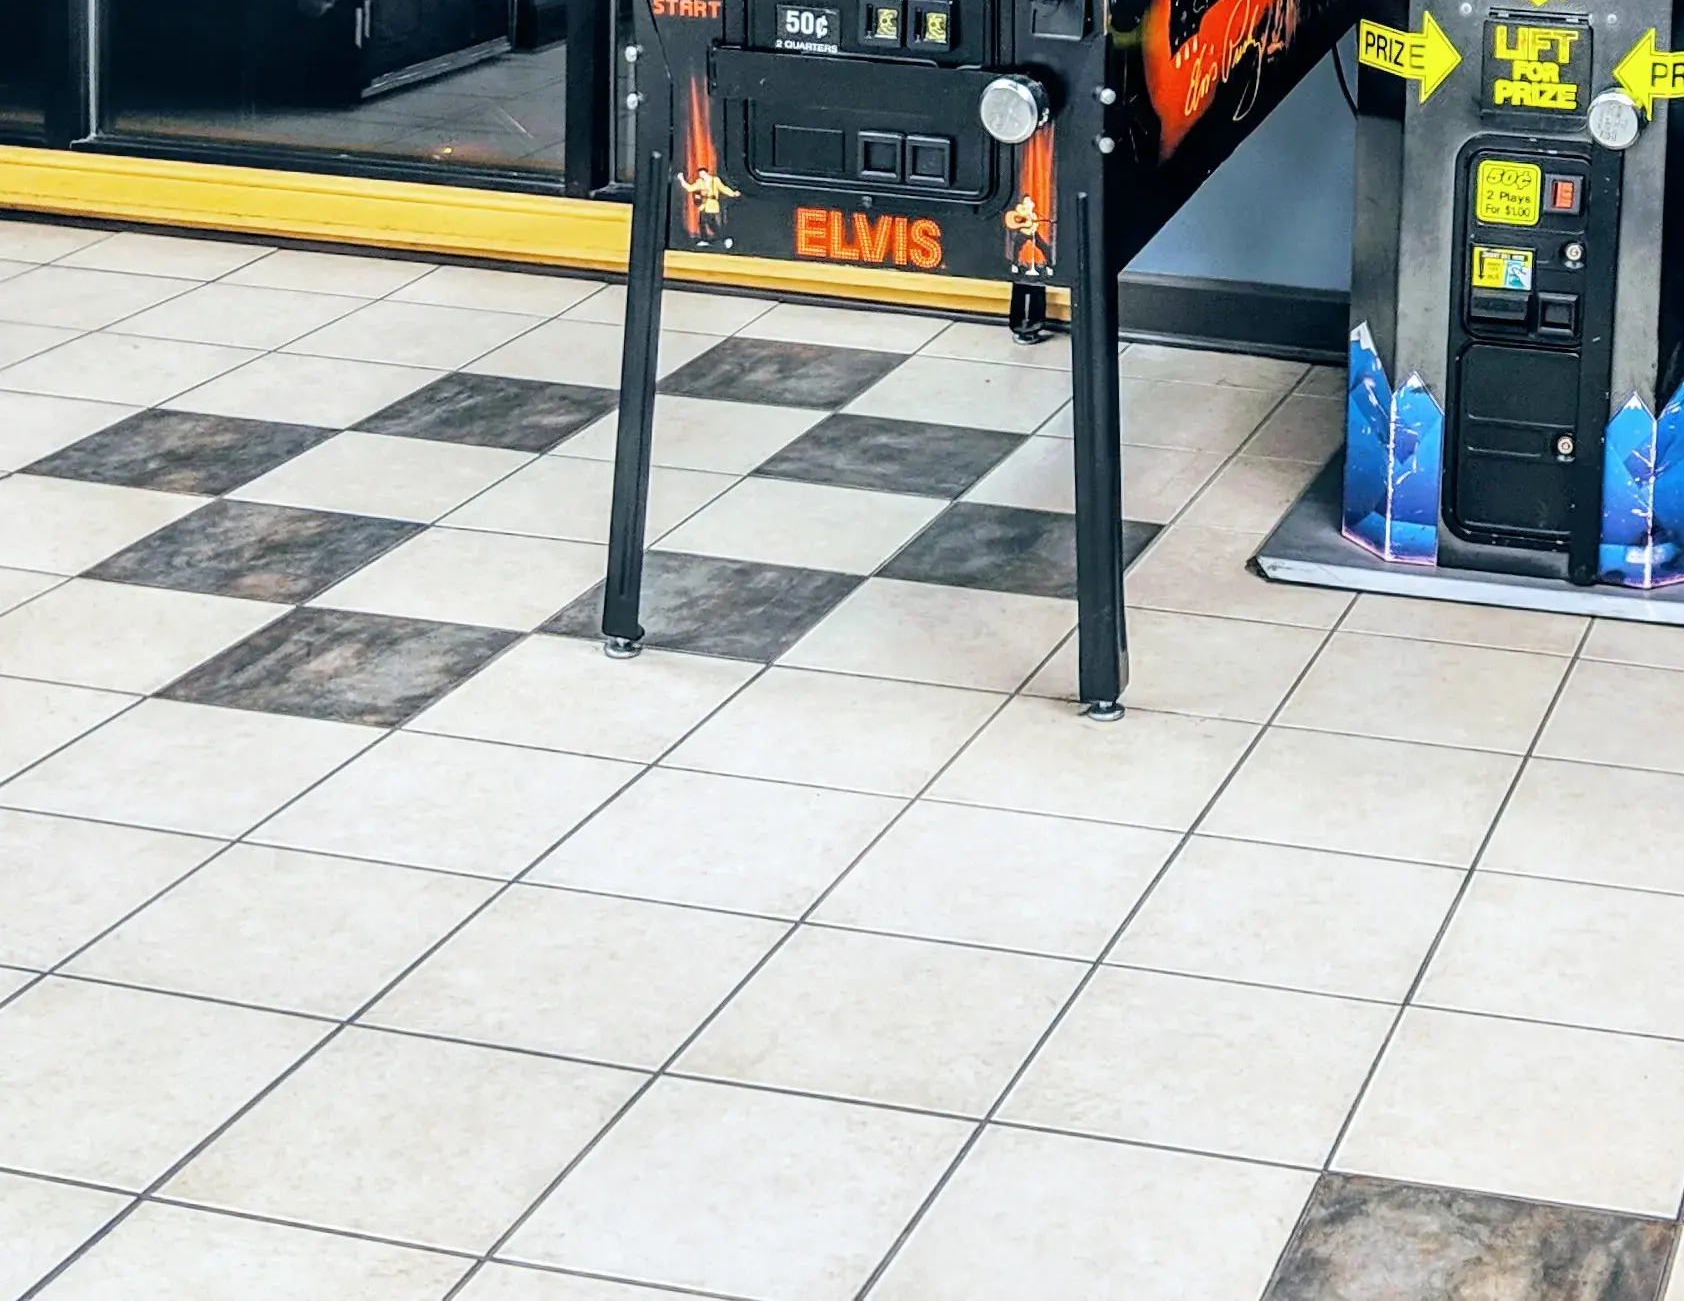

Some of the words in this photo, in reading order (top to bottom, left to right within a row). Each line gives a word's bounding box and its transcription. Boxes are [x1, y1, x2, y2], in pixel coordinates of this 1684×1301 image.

[785, 9, 829, 39] 50¢
[775, 40, 783, 49] 2
[784, 40, 839, 54] QUARTERS
[1364, 29, 1426, 70] PRIZE
[1494, 24, 1579, 64] LIFT
[1511, 60, 1560, 84] FOR
[1493, 79, 1578, 111] PRIZE
[1486, 167, 1532, 191] 50¢
[1485, 203, 1500, 214] For
[1505, 206, 1531, 218] $1.00
[1487, 191, 1494, 200] 2
[1500, 191, 1531, 204] Plays
[795, 209, 943, 269] ELVIS
